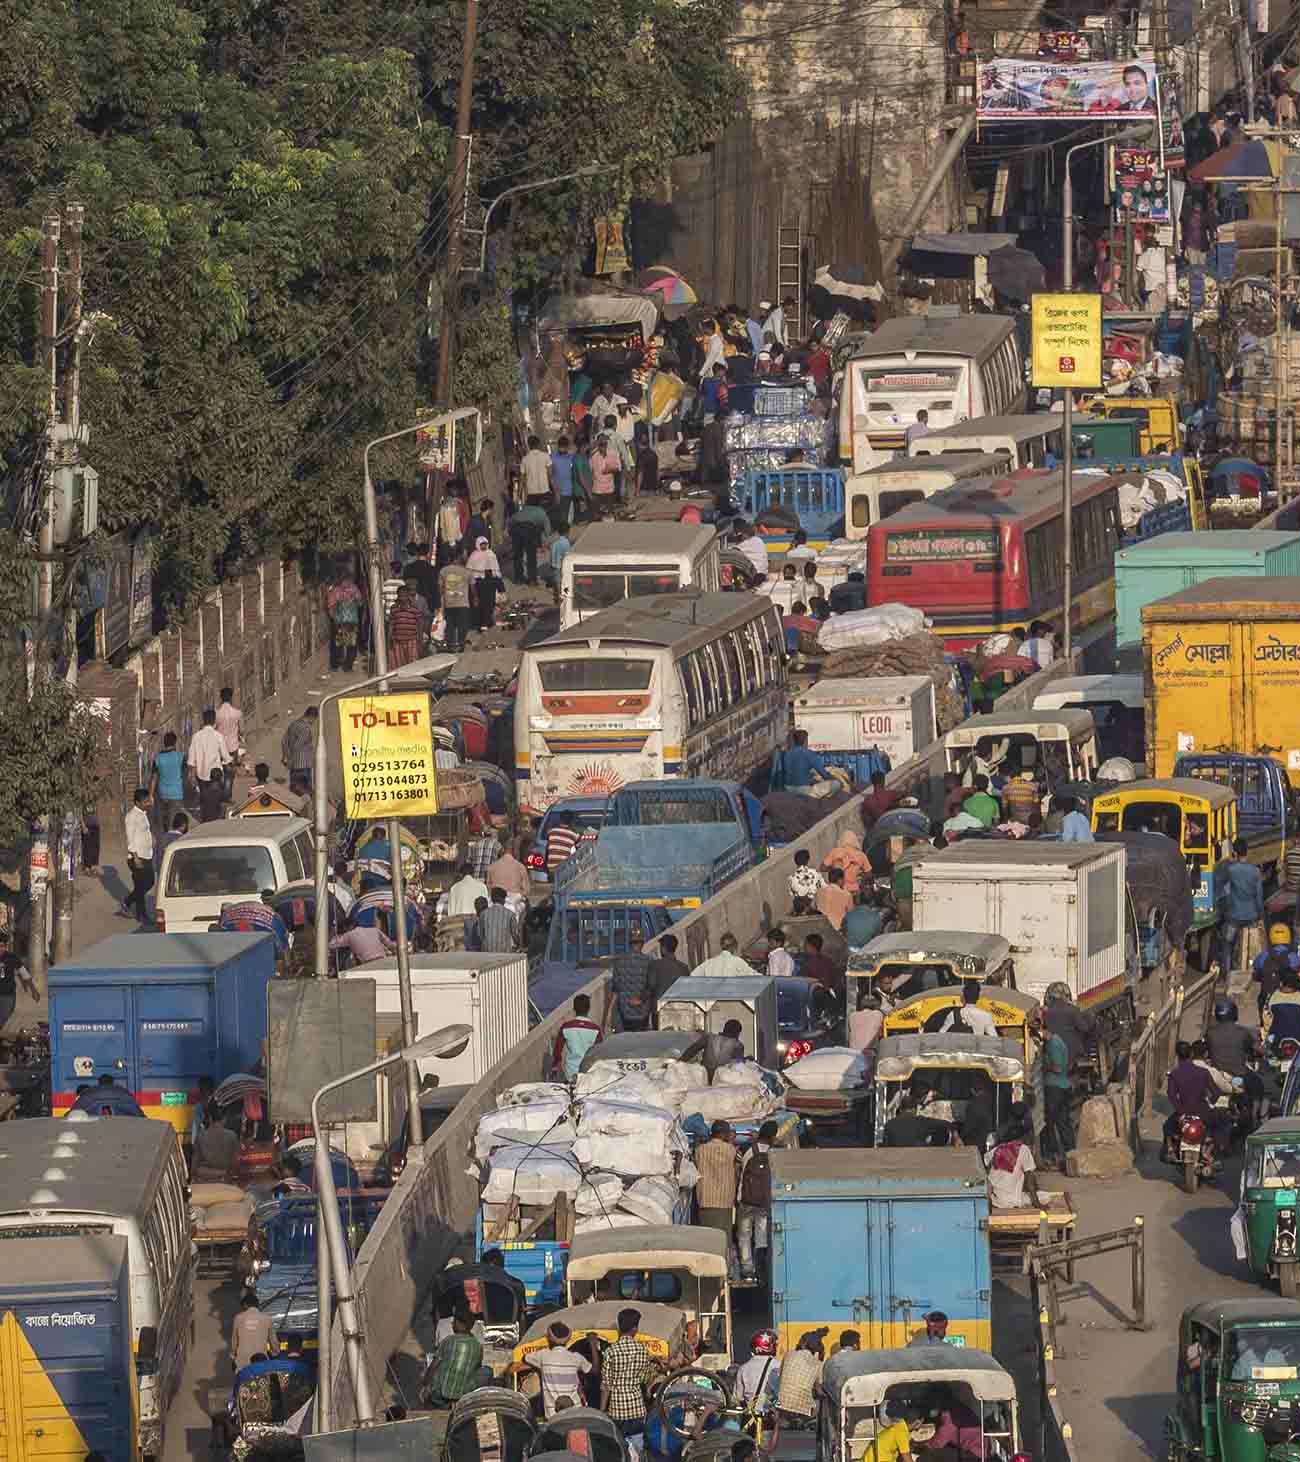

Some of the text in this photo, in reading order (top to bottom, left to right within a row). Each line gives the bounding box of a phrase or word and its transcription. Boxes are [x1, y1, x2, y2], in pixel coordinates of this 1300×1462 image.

[1185, 644, 1231, 664] মোল্লা
[349, 709, 421, 729] TO-LET
[862, 716, 892, 734] LEON
[352, 759, 425, 773] 029513764
[25, 1311, 96, 1328] কাজে নিয়োজিত
